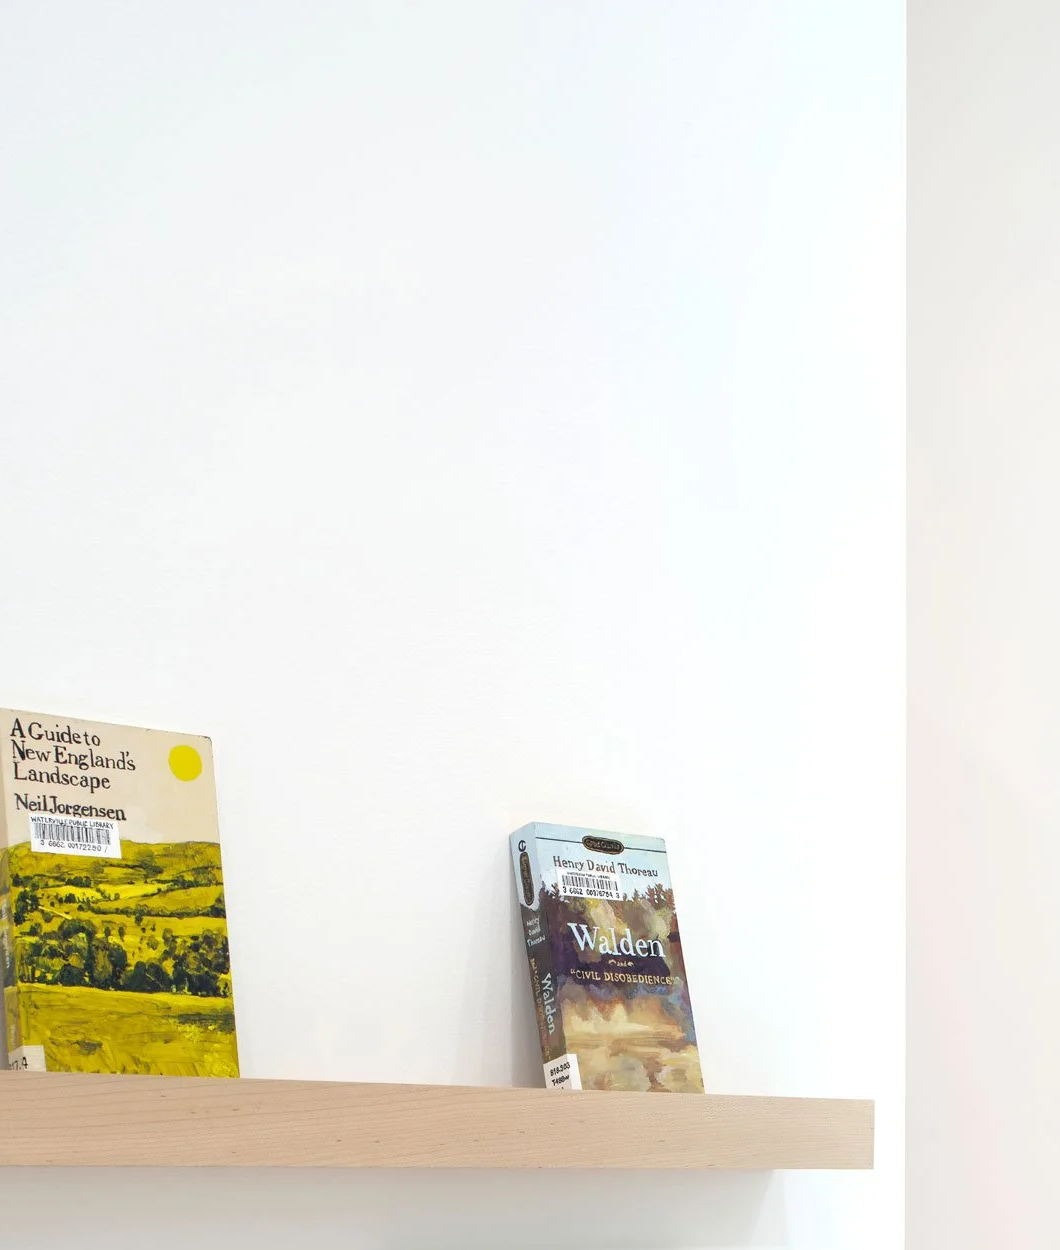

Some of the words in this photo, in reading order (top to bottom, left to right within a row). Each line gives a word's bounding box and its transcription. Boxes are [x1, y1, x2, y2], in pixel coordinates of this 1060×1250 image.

[10, 718, 26, 739] A
[27, 722, 82, 745] Guide
[84, 732, 101, 747] to
[11, 739, 51, 763] New
[53, 745, 137, 771] England's
[13, 761, 111, 794] Landscape
[14, 793, 48, 812] Neil
[49, 796, 127, 821] Jorgensen
[89, 821, 114, 830] LIBRARY
[552, 855, 585, 871] Henry
[586, 860, 616, 874] David
[617, 862, 659, 878] Thoreau
[567, 922, 666, 958] Walden
[541, 972, 557, 1036] Walden
